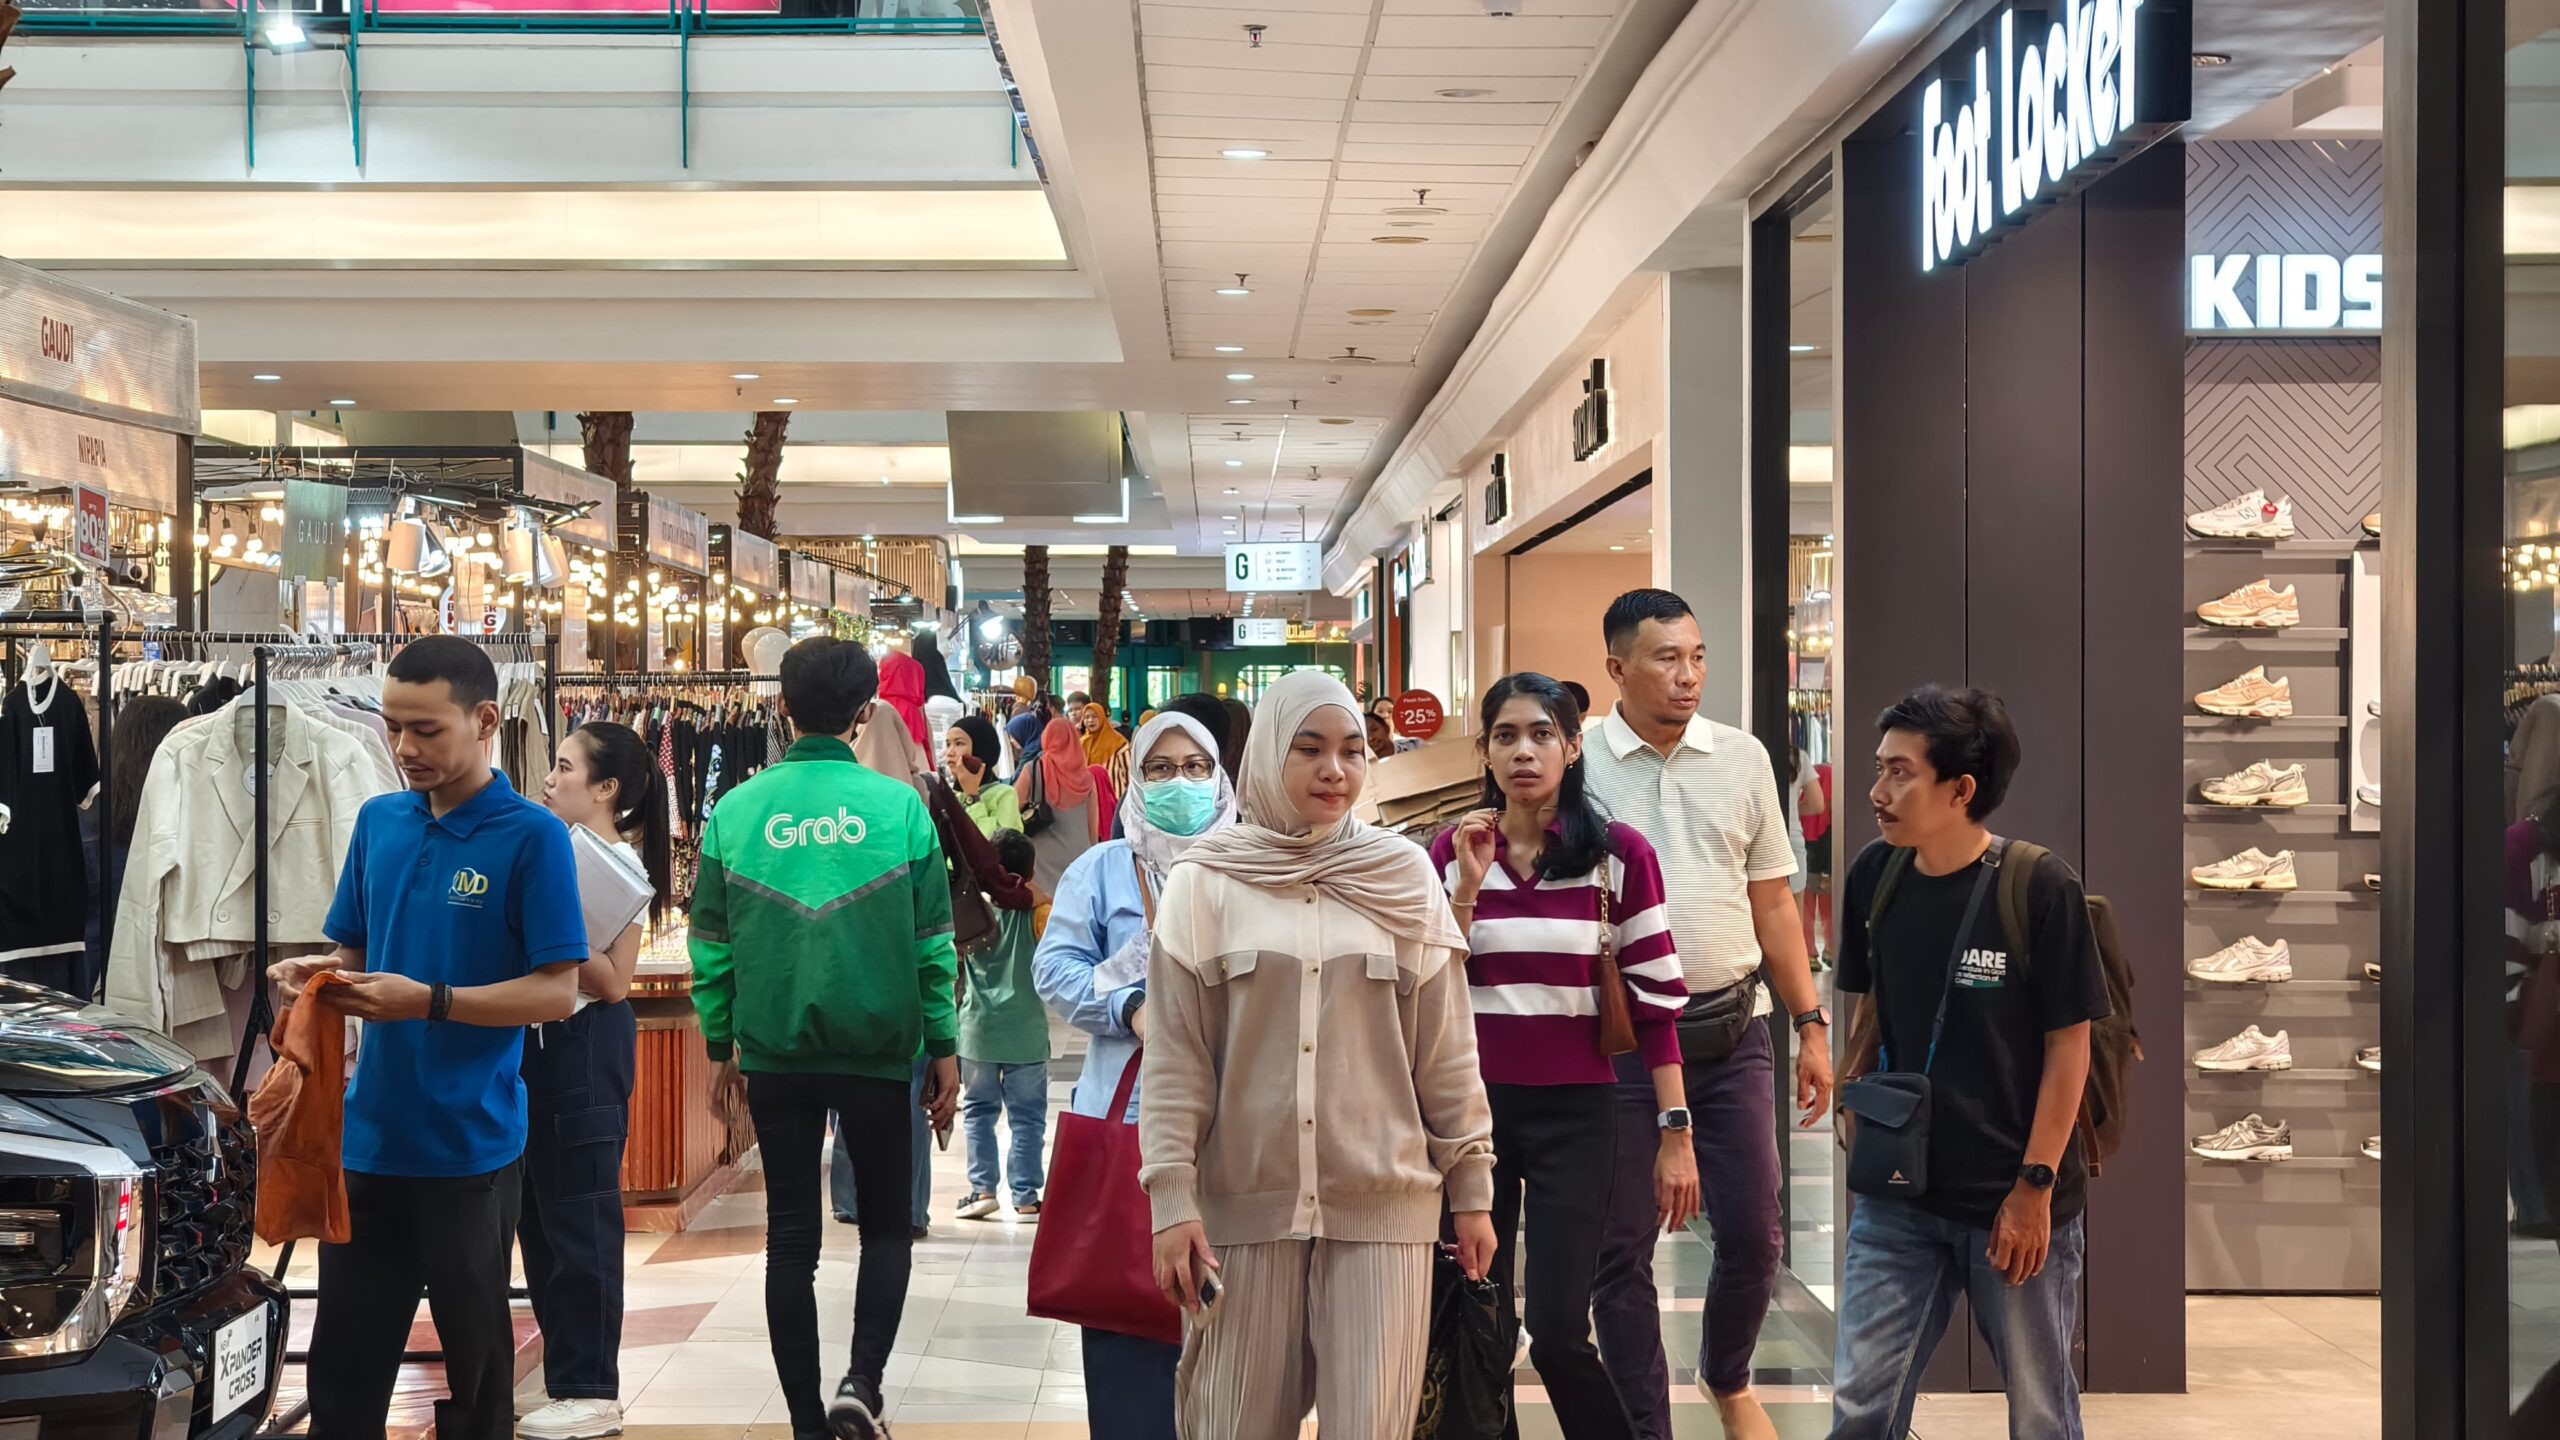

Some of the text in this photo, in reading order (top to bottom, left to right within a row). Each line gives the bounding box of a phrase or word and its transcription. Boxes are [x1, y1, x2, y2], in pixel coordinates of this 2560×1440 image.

[1923, 0, 2144, 271] Foot Locker
[2191, 254, 2382, 329] KIDS
[41, 316, 74, 364] GAUDI
[78, 434, 106, 467] NIPAPIA
[298, 519, 334, 545] GAUDI
[1235, 553, 1249, 580] G
[1238, 624, 1247, 639] G
[1404, 708, 1437, 725] 25%
[765, 806, 866, 848] Grab
[220, 1336, 262, 1381] XPANDER
[229, 1366, 257, 1400] CROSS
